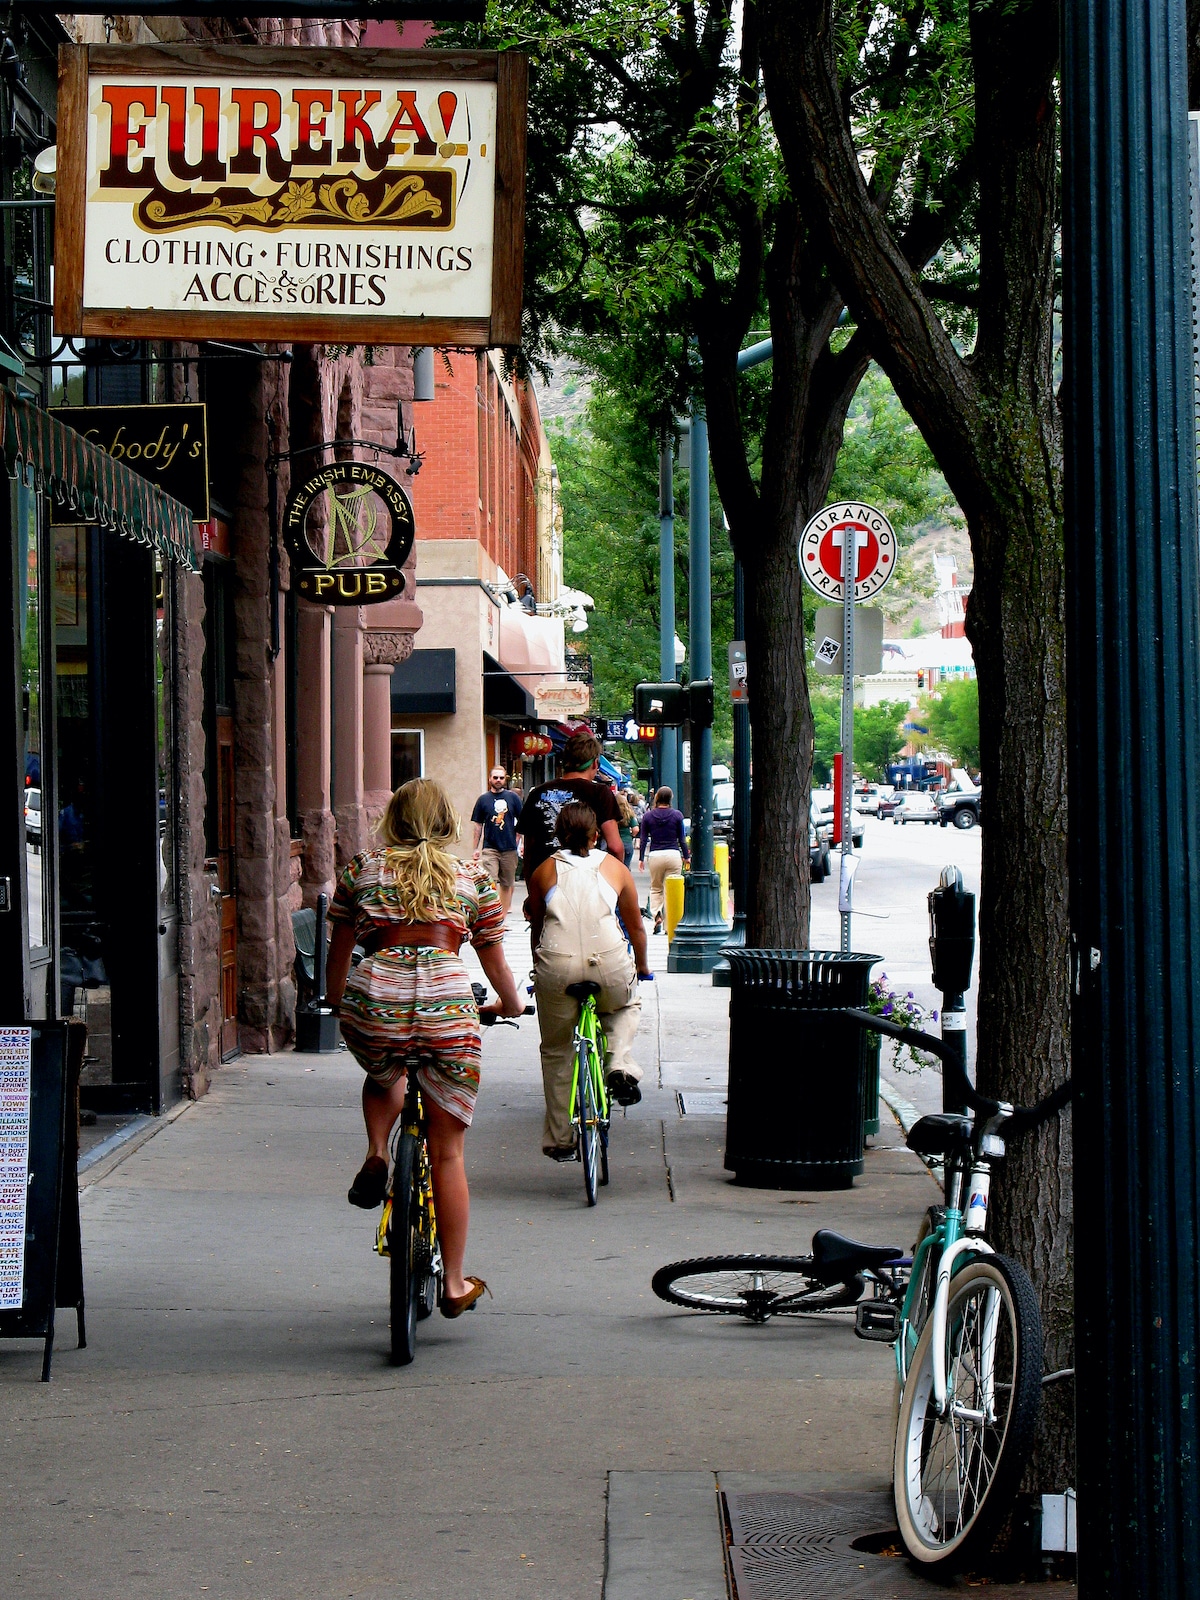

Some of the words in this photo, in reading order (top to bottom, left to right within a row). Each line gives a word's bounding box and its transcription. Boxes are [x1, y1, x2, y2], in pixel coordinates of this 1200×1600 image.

[100, 85, 458, 189] EUREKA!
[105, 239, 254, 267] CLOTHING
[276, 241, 473, 272] FURNISHINGS
[289, 492, 309, 527] THE
[304, 466, 346, 494] IRISH
[351, 466, 410, 525] EMBASSY
[202, 523, 210, 549] IRE
[808, 507, 890, 545] DURANGO
[314, 573, 388, 598] PUB
